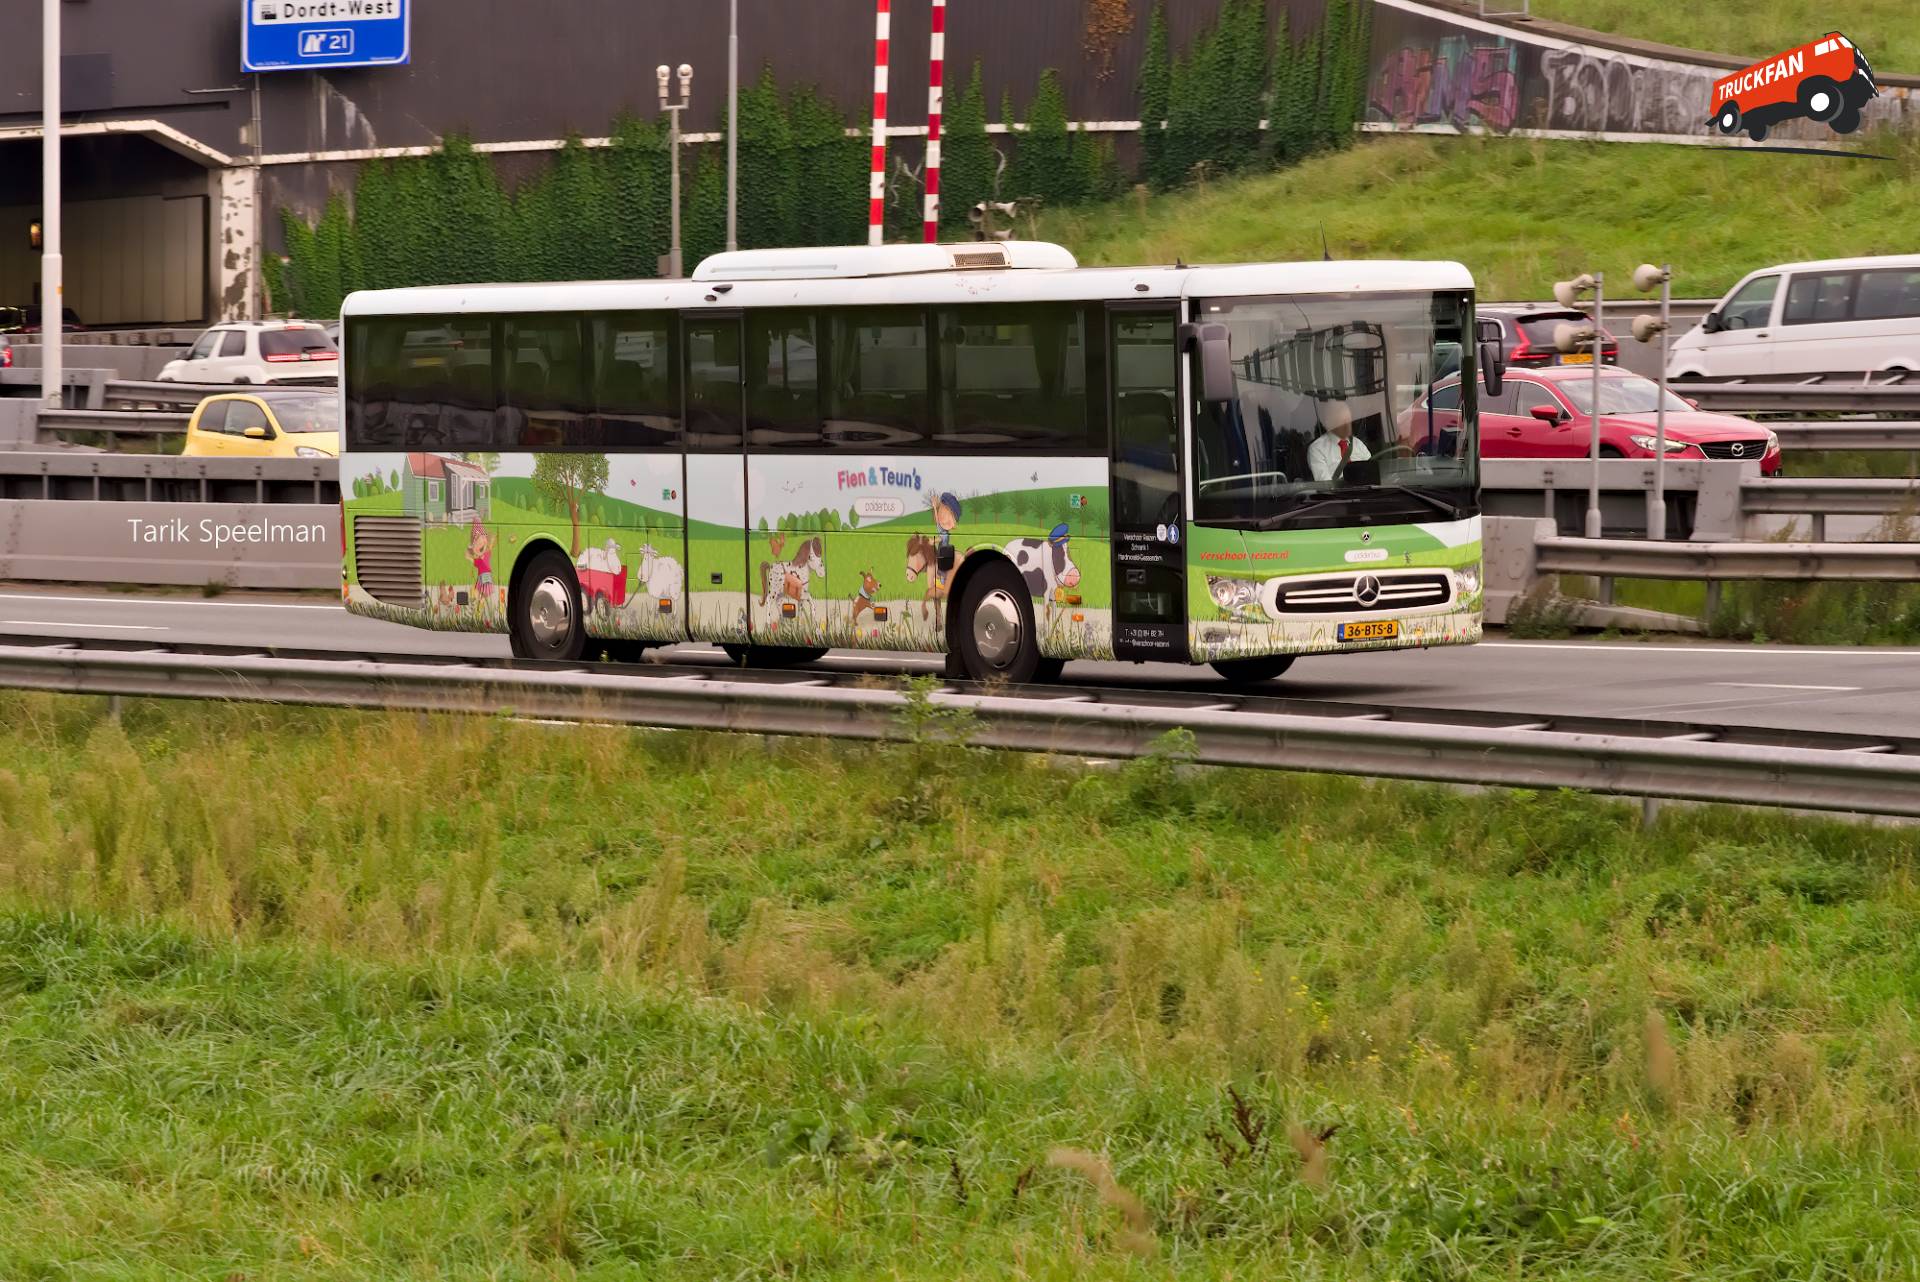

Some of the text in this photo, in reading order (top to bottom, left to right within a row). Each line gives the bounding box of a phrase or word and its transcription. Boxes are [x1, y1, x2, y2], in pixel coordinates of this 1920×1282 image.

[283, 1, 393, 18] Dordt-West
[329, 35, 348, 50] 21
[837, 466, 922, 491] Fien & Teun's
[1347, 623, 1393, 637] 36-BTS-8
